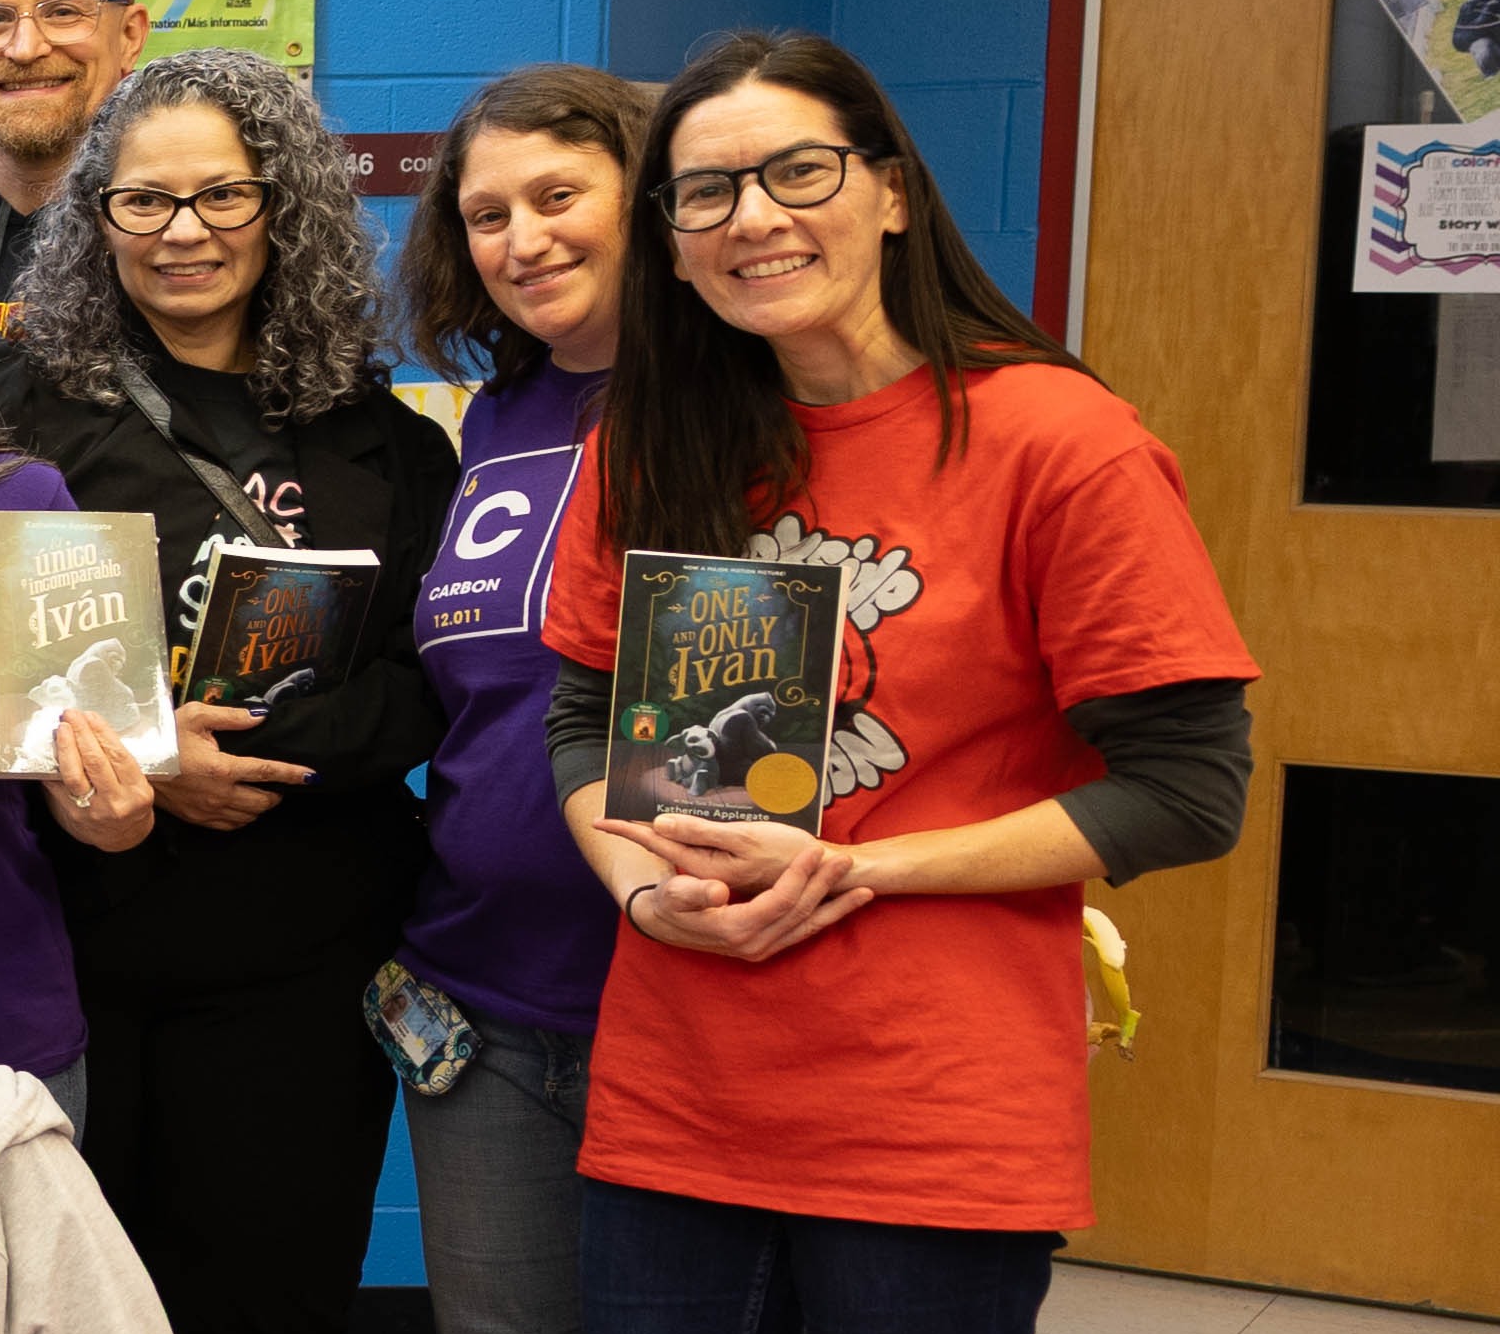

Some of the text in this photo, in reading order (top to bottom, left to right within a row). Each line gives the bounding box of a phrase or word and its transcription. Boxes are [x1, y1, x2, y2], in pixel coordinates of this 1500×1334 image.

[464, 475, 479, 497] 6
[455, 490, 531, 560] C
[35, 541, 97, 577] único
[264, 585, 313, 616] ONE
[429, 578, 500, 601] CARBON
[690, 586, 750, 623] ONE
[29, 589, 129, 650] Iván
[434, 608, 481, 629] 12.011
[699, 616, 780, 655] ONLY
[668, 645, 778, 701] Ivan
[657, 804, 710, 818] Katherine
